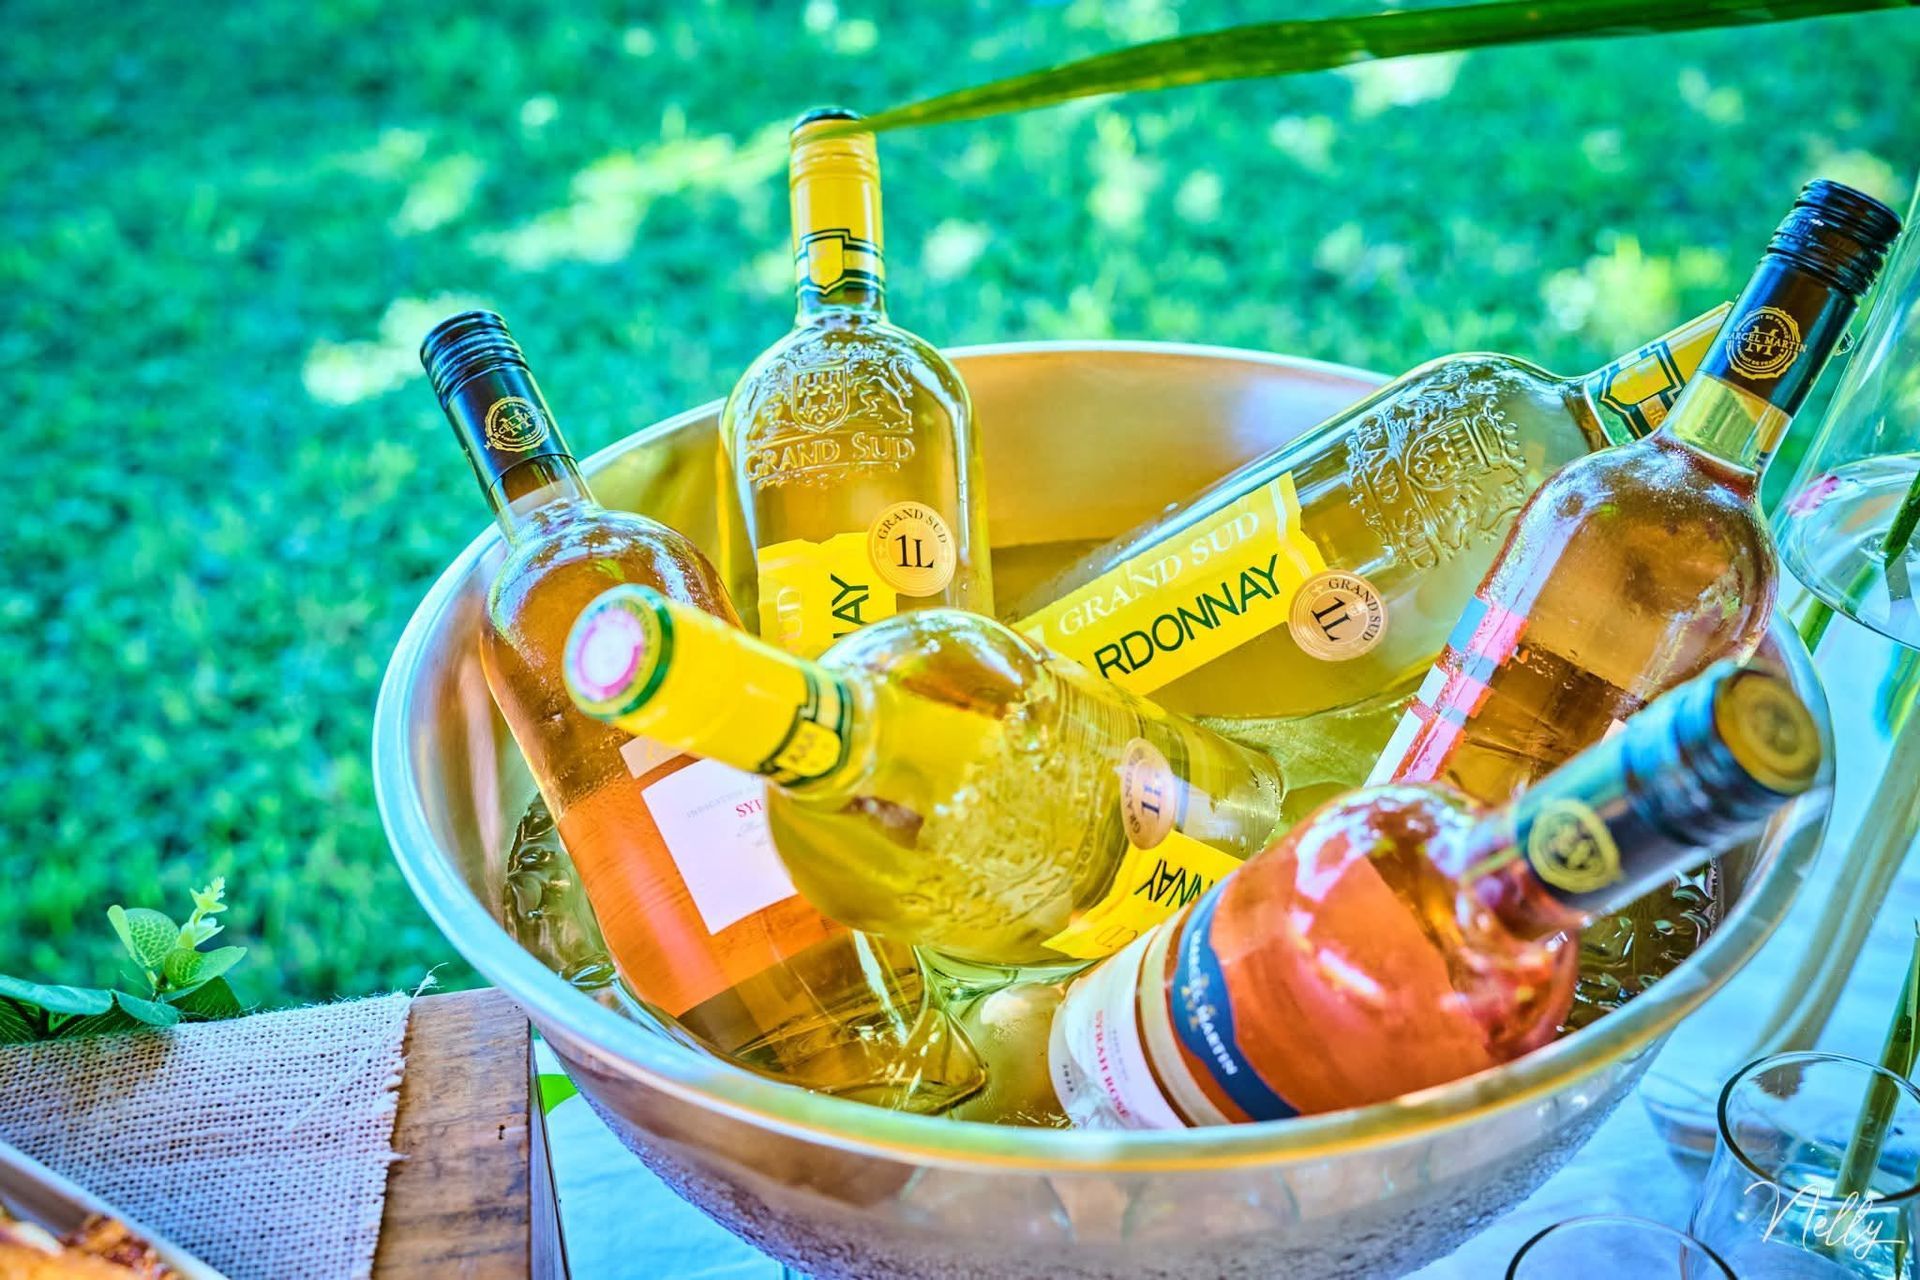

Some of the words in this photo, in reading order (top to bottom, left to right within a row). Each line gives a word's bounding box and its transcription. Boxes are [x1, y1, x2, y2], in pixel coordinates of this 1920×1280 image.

[1726, 331, 1761, 343] ARCEL
[1764, 336, 1808, 353] MARTIN
[744, 438, 840, 480] GRAND
[877, 508, 923, 540] GRAND
[926, 515, 948, 544] SUD
[895, 534, 935, 568] 1L
[1059, 553, 1183, 637] GRAND
[1190, 511, 1260, 567] SUD
[830, 573, 869, 639] AY
[1094, 553, 1281, 680] RDONNAY
[1311, 597, 1352, 642] 1L
[1328, 578, 1379, 612] GRAND
[1362, 615, 1381, 642] SUD
